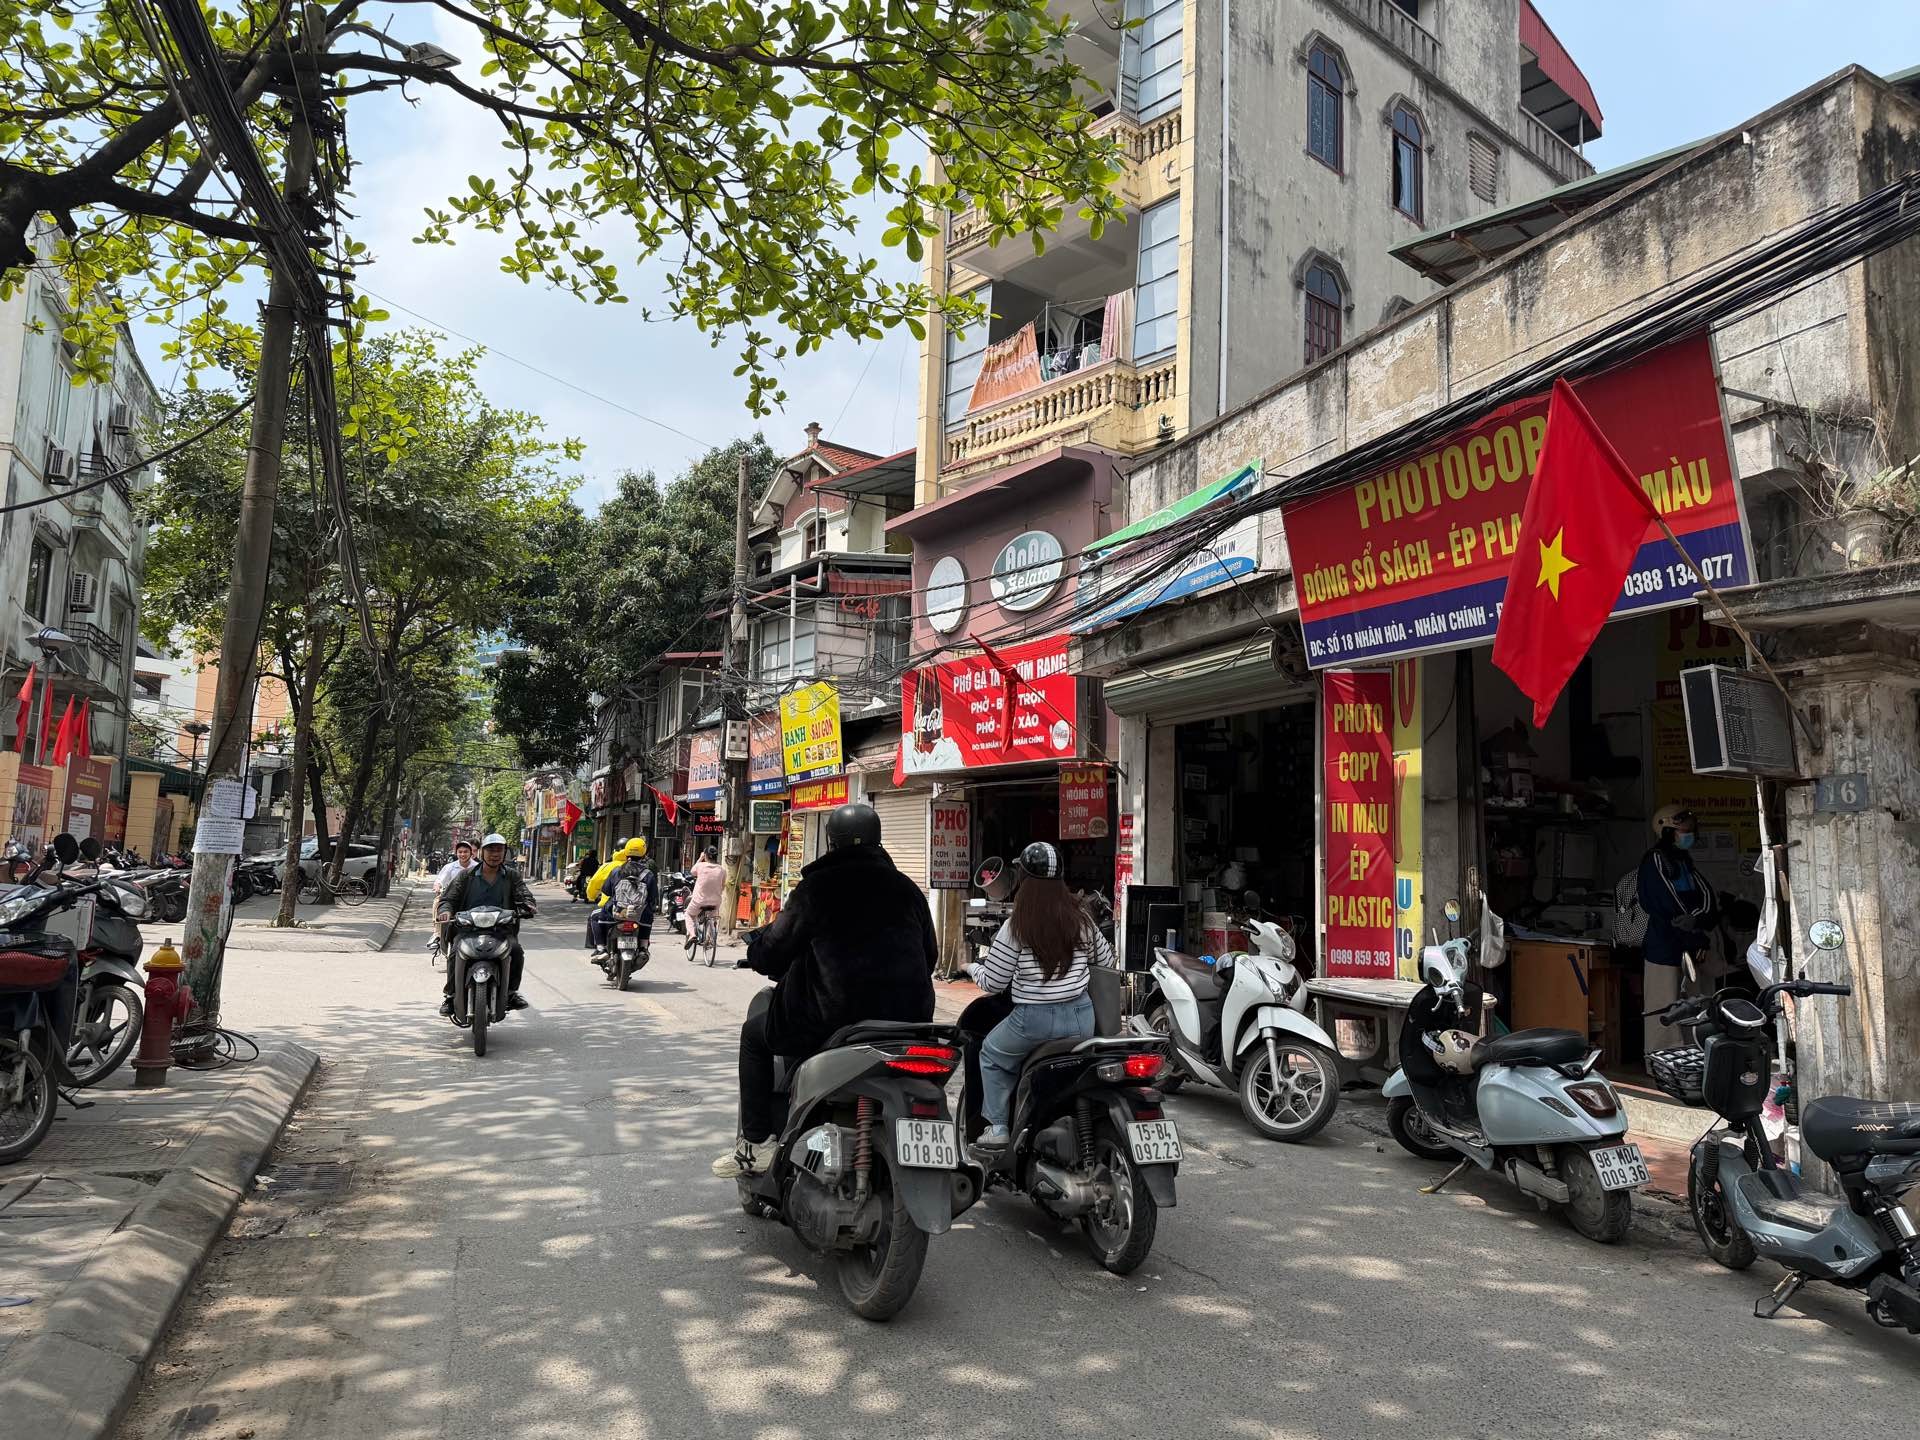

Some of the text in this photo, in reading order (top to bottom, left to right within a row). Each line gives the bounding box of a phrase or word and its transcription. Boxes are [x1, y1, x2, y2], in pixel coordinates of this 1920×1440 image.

[1354, 415, 1547, 529] PHOTOCOP
[1640, 456, 1712, 514] MÀU
[1302, 512, 1523, 605] ĐÓNG SỔ SÁCH ÉP PLA
[1624, 553, 1733, 597] 0388 134 077
[1326, 629, 1340, 654] SỐ
[1341, 633, 1354, 651] 18
[1354, 625, 1383, 649] NHÂN
[1384, 619, 1407, 643] HÒA
[1414, 612, 1447, 637] NHÂN
[1448, 605, 1486, 631] CHÍNH
[953, 668, 972, 694] PHỞ
[974, 666, 987, 690] GÀ
[1037, 653, 1067, 678] RANG
[970, 695, 989, 714] PHỞ
[1333, 703, 1383, 733] PHOTO
[976, 711, 1039, 734] PHỞ XÀO
[784, 726, 806, 747] BÁNH
[1338, 751, 1379, 782] COPY
[1826, 780, 1857, 804] 16
[934, 804, 968, 831] PHỞ
[1331, 796, 1389, 834] IN MÀU
[1350, 843, 1370, 881] ÉP
[1328, 895, 1392, 929] PLASTIC
[1330, 948, 1391, 967] 0989 859 393
[907, 1122, 946, 1144] 19-AK
[1135, 1122, 1172, 1141] 15-B4
[902, 1143, 953, 1165] 018.90
[1135, 1141, 1181, 1161] 092.23
[1595, 1146, 1639, 1169] 98-MD4
[1601, 1164, 1647, 1187] 009.36
